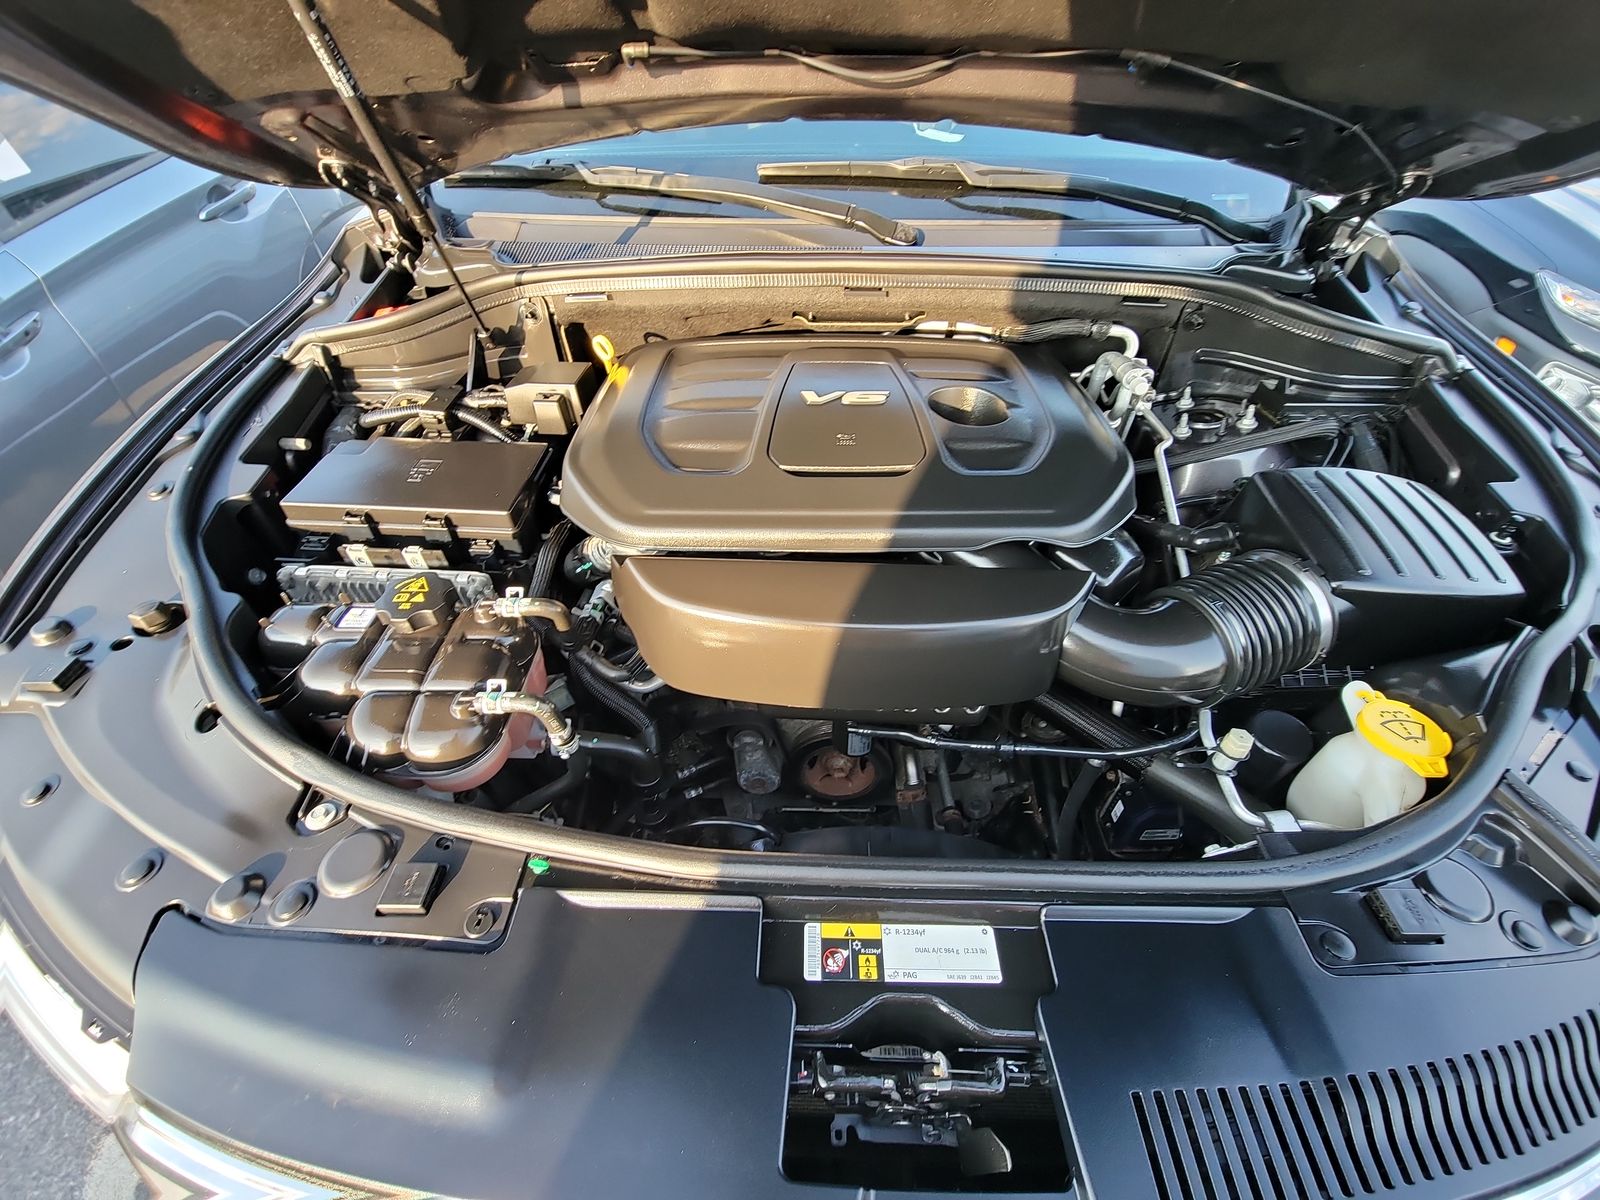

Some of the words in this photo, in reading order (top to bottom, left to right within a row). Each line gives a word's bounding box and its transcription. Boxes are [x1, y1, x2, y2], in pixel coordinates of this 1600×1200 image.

[800, 390, 891, 406] V6
[895, 928, 926, 937] R-1234yf
[979, 947, 988, 955] lb)
[902, 971, 918, 979] PAG
